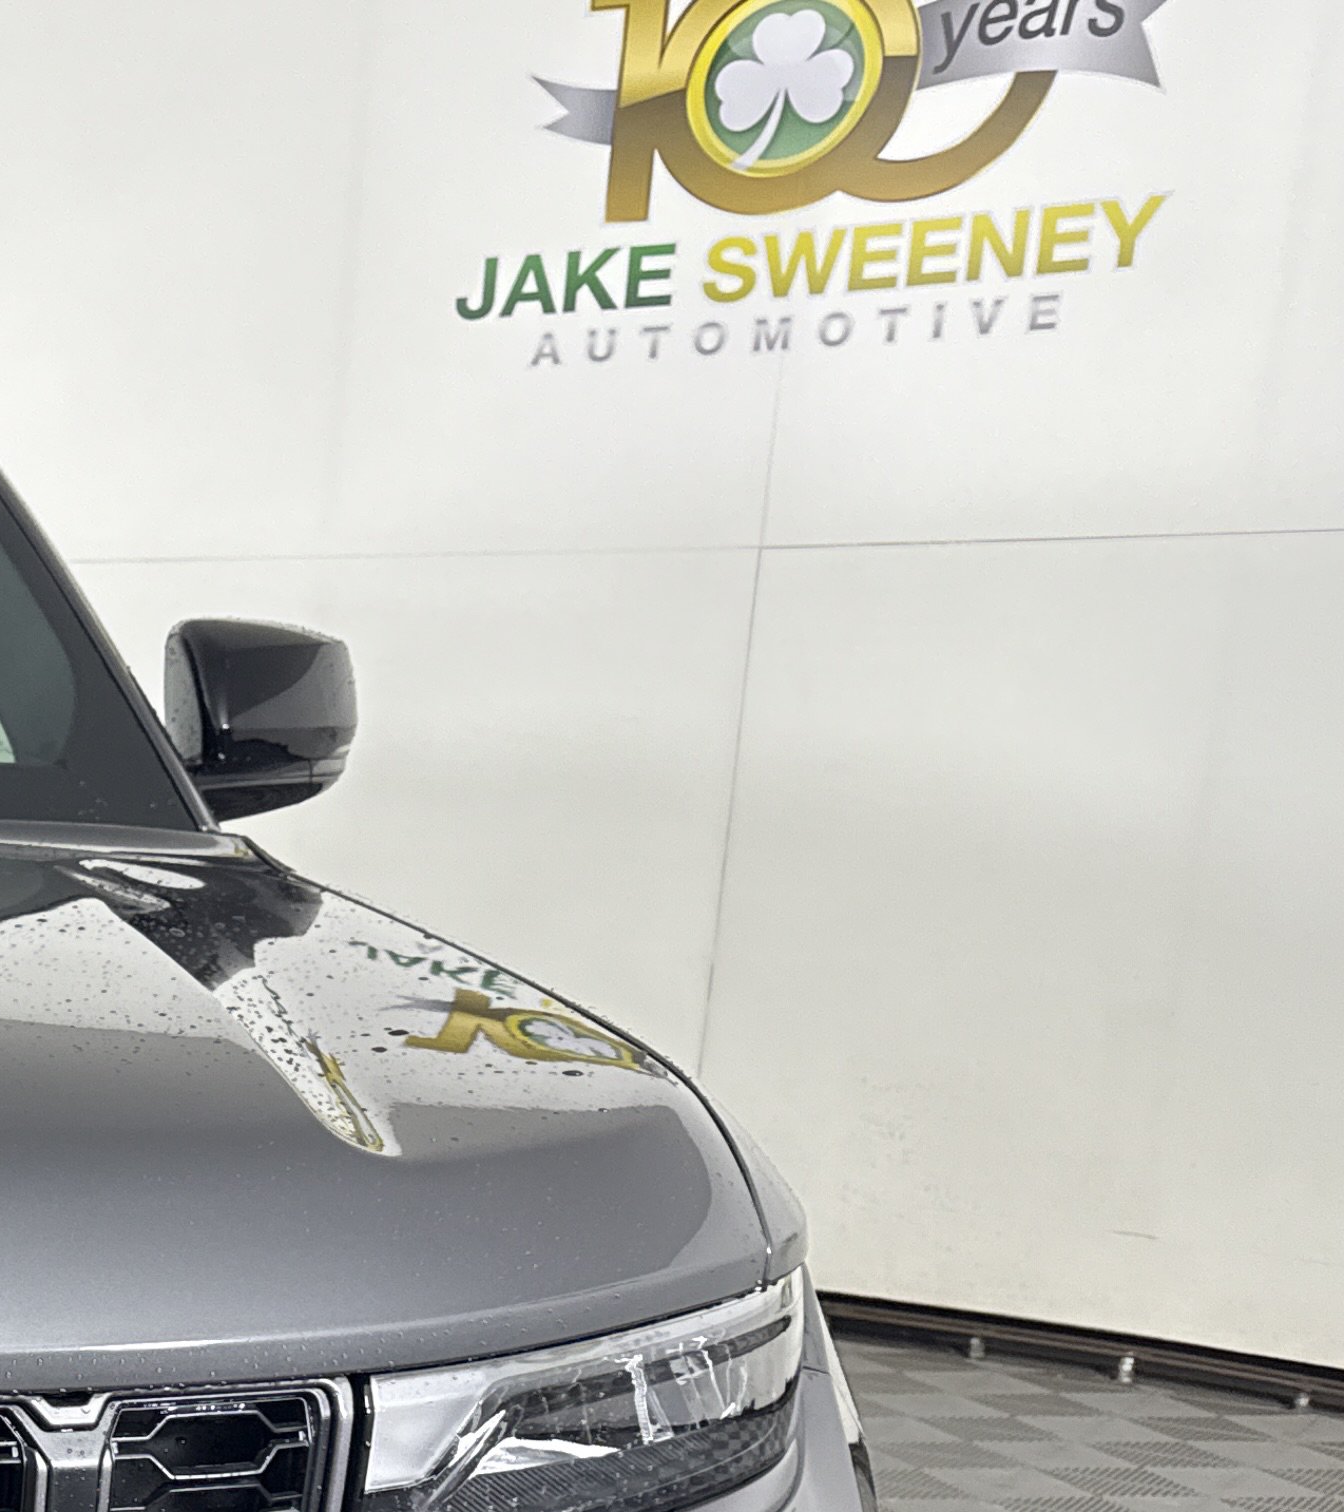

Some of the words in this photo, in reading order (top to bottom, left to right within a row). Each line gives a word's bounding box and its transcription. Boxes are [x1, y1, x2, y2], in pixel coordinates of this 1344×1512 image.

[932, 0, 1125, 75] years
[455, 243, 677, 320] JAKE
[702, 191, 1170, 304] SWEENEY
[529, 294, 1061, 367] AUTOMOTIVE
